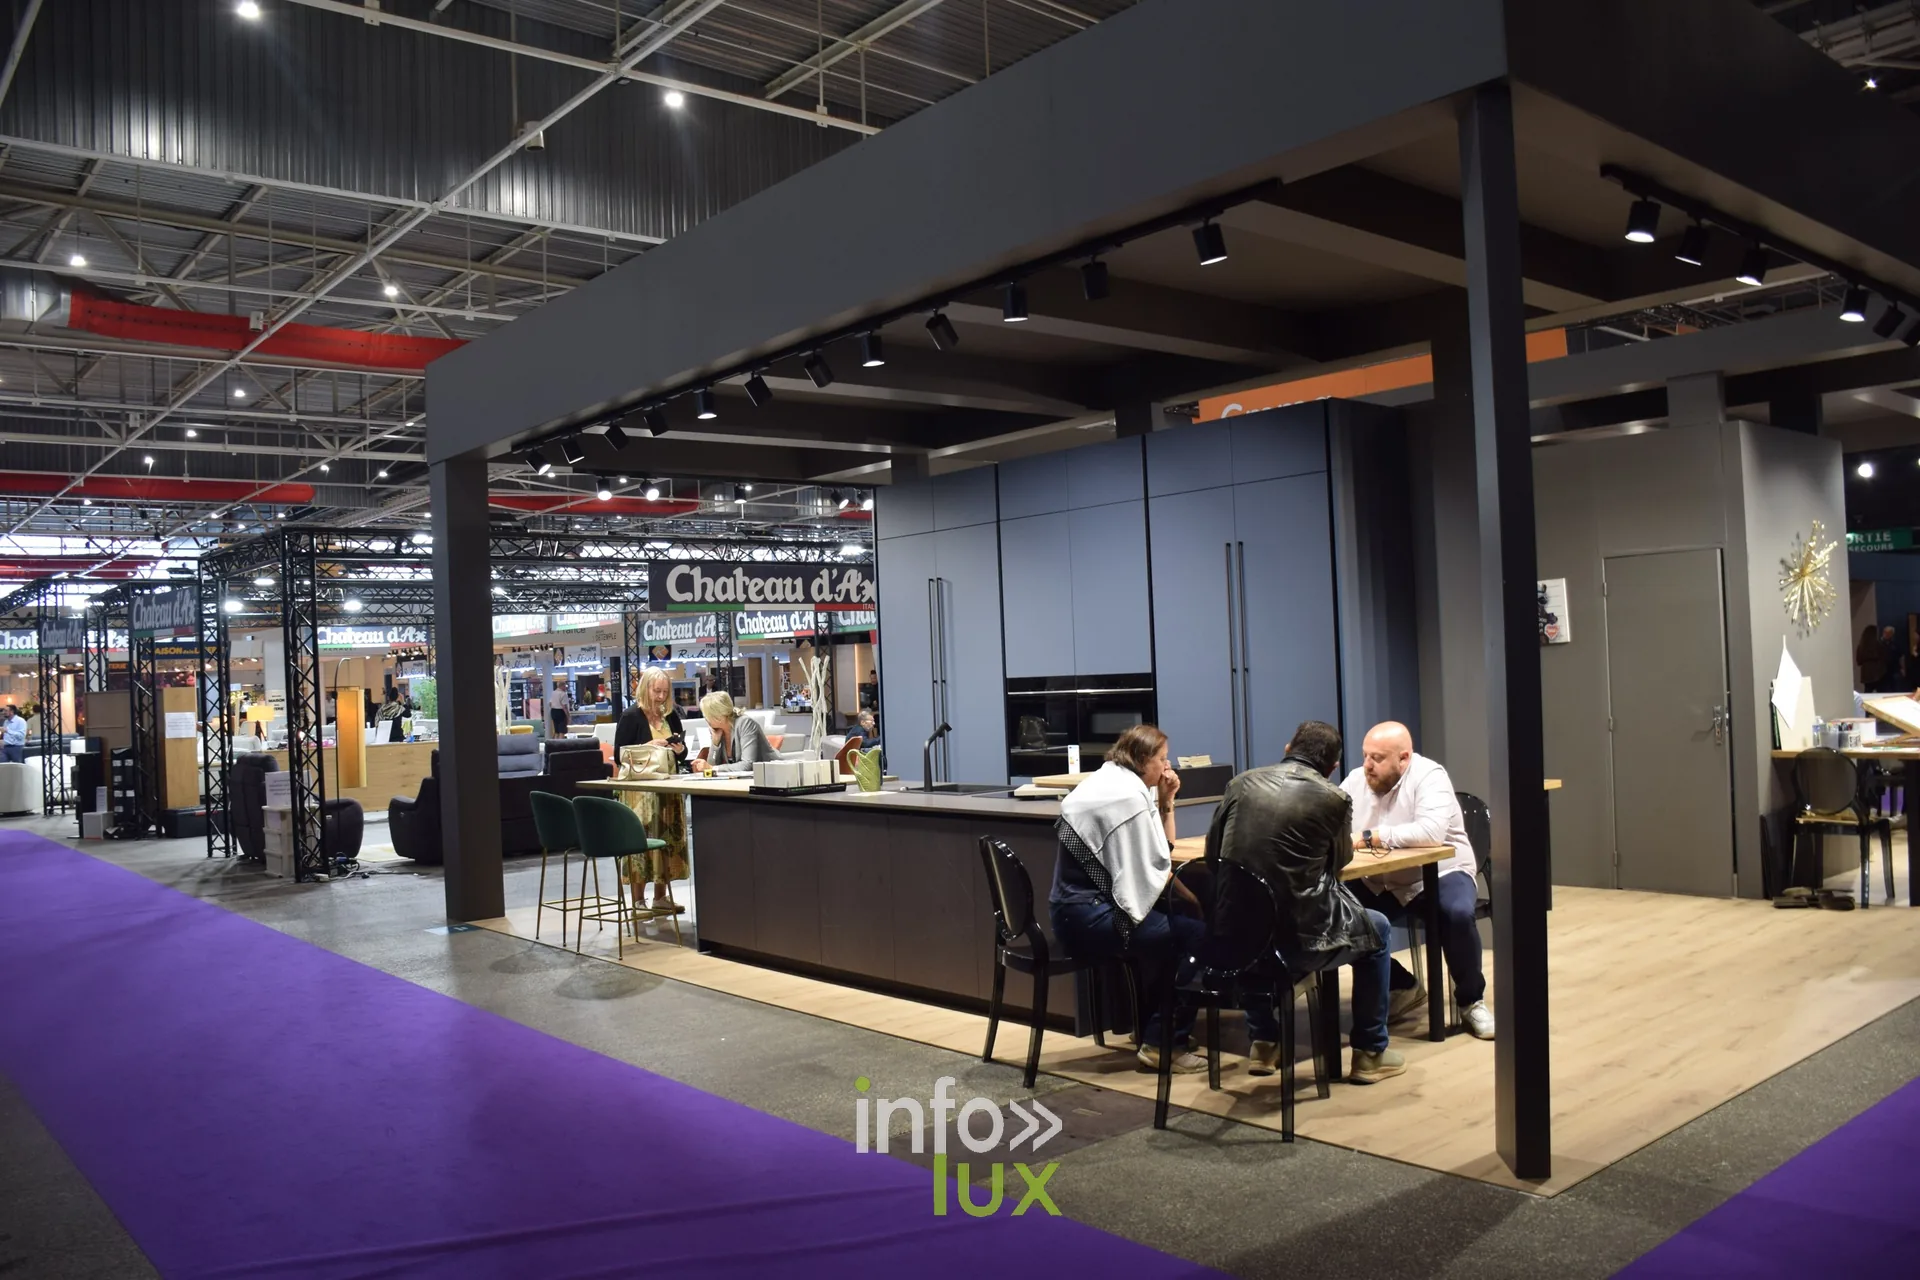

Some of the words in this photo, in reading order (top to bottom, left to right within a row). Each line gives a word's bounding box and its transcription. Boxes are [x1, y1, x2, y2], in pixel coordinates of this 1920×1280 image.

[666, 564, 805, 603] Chateau
[133, 596, 172, 630] Chateau
[735, 611, 785, 635] Chateau
[317, 627, 385, 645] Chateau
[387, 626, 428, 643] d'Ax
[643, 619, 693, 642] Chateau
[155, 645, 183, 655] AISON
